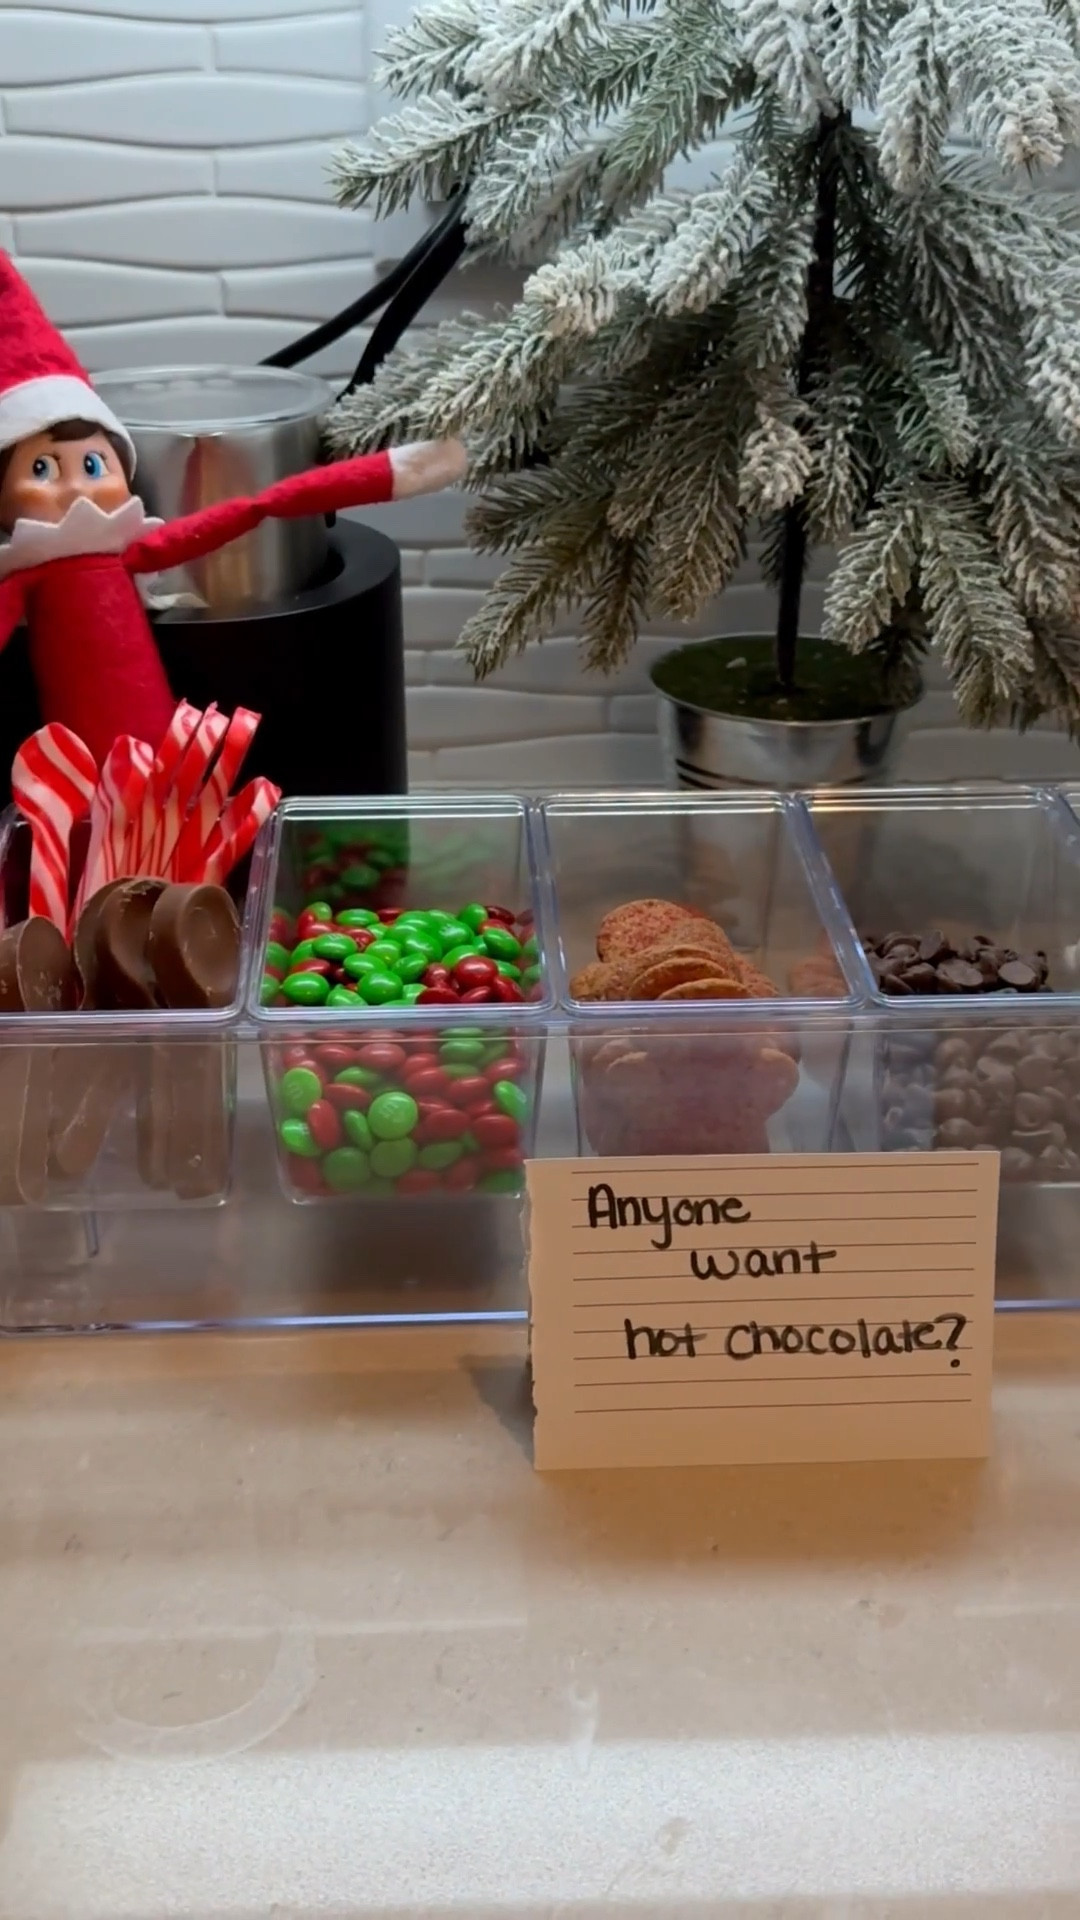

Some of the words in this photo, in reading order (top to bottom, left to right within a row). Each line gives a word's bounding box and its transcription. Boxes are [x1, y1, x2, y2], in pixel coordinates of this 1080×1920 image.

[588, 1183, 751, 1250] Anyone
[690, 1240, 837, 1281] want
[624, 1318, 707, 1360] hot
[724, 1312, 967, 1368] chocolate?
